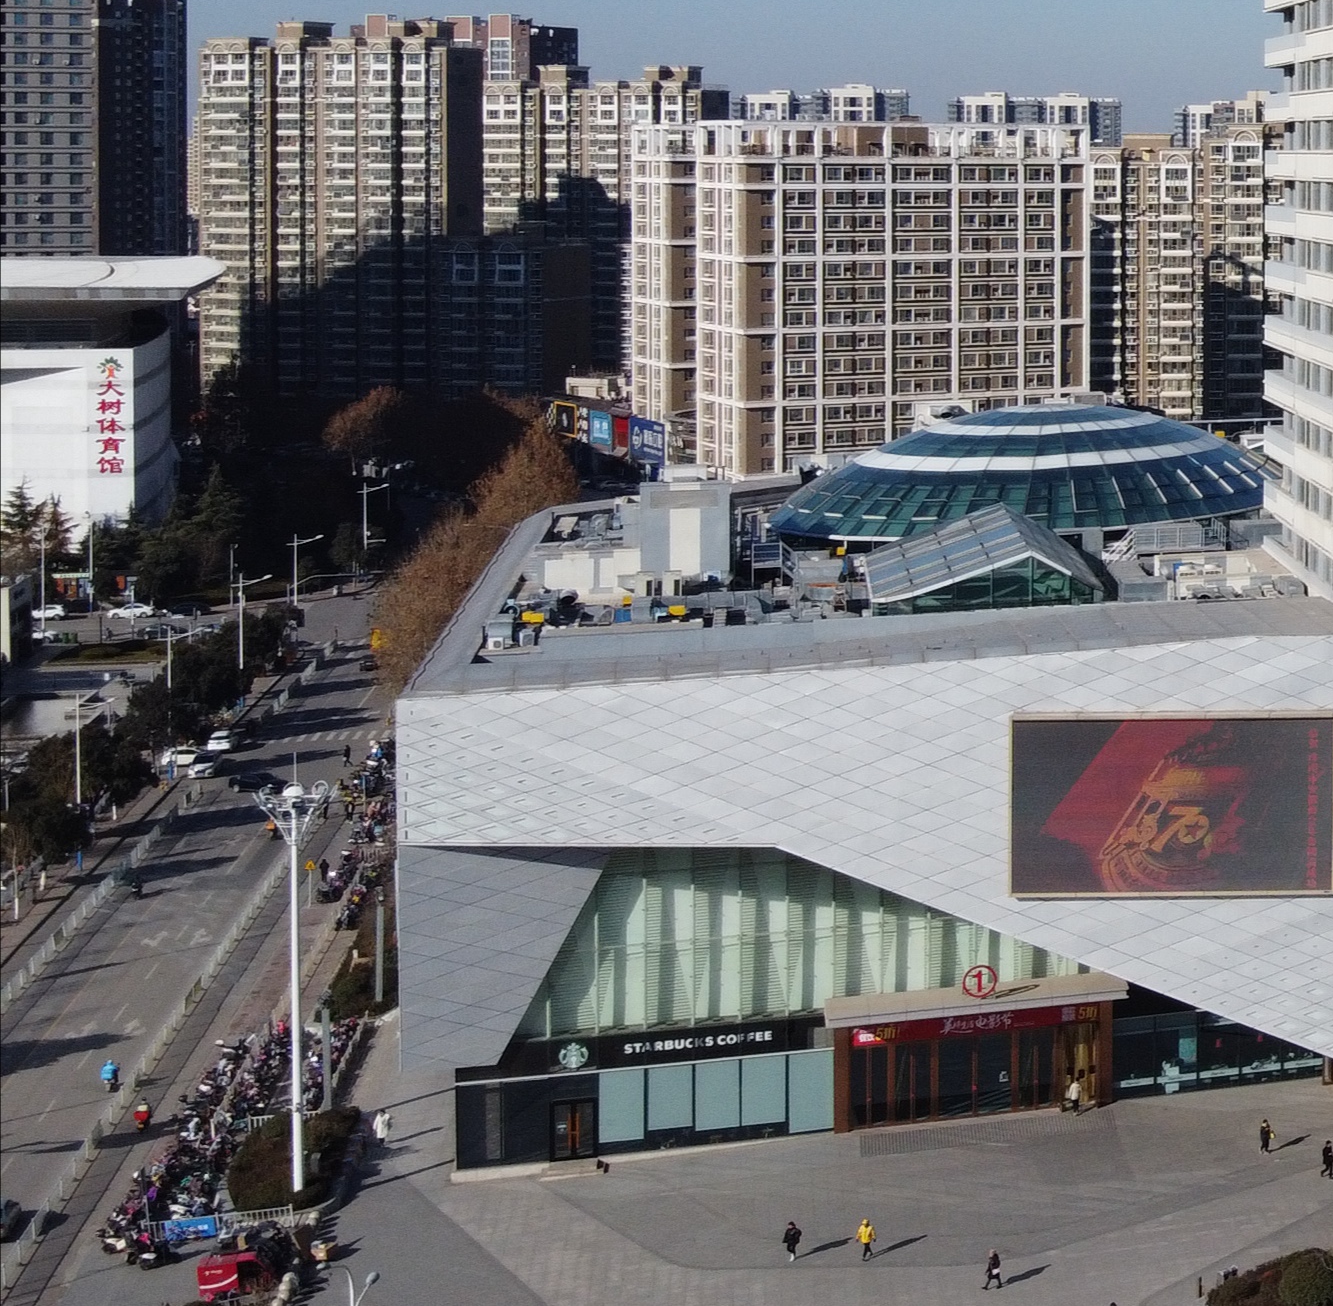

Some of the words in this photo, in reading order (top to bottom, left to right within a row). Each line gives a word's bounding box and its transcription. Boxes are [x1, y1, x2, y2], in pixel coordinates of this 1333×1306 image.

[95, 380, 126, 474] 大树体育馆
[623, 1035, 714, 1055] STARBUCKS
[716, 1030, 773, 1045] COFFEE
